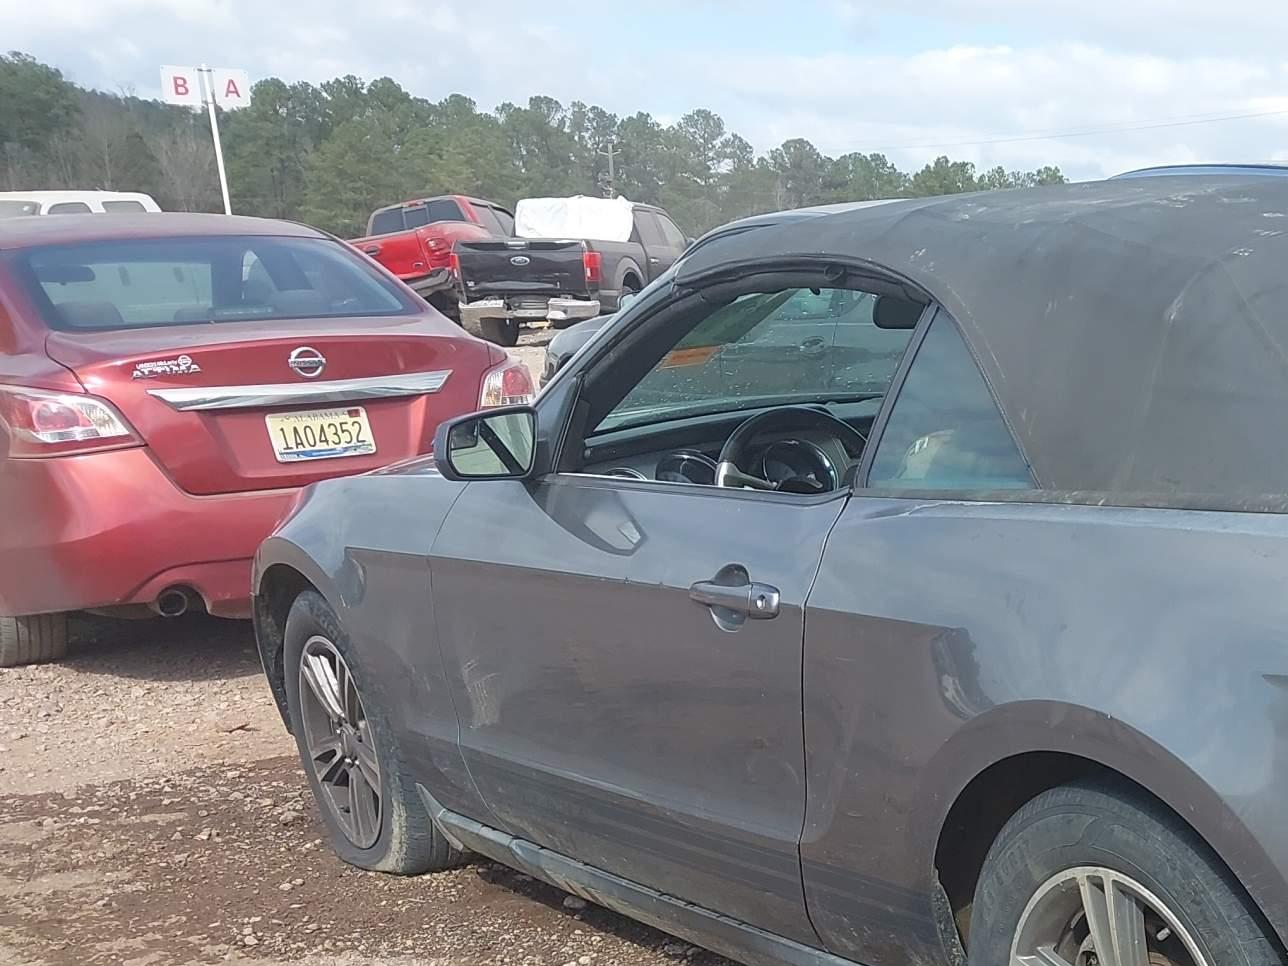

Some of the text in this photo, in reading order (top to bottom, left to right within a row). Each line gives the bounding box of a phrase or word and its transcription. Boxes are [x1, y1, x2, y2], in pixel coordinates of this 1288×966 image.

[173, 76, 189, 96] B
[225, 79, 240, 97] A
[280, 421, 366, 450] 1A04352
